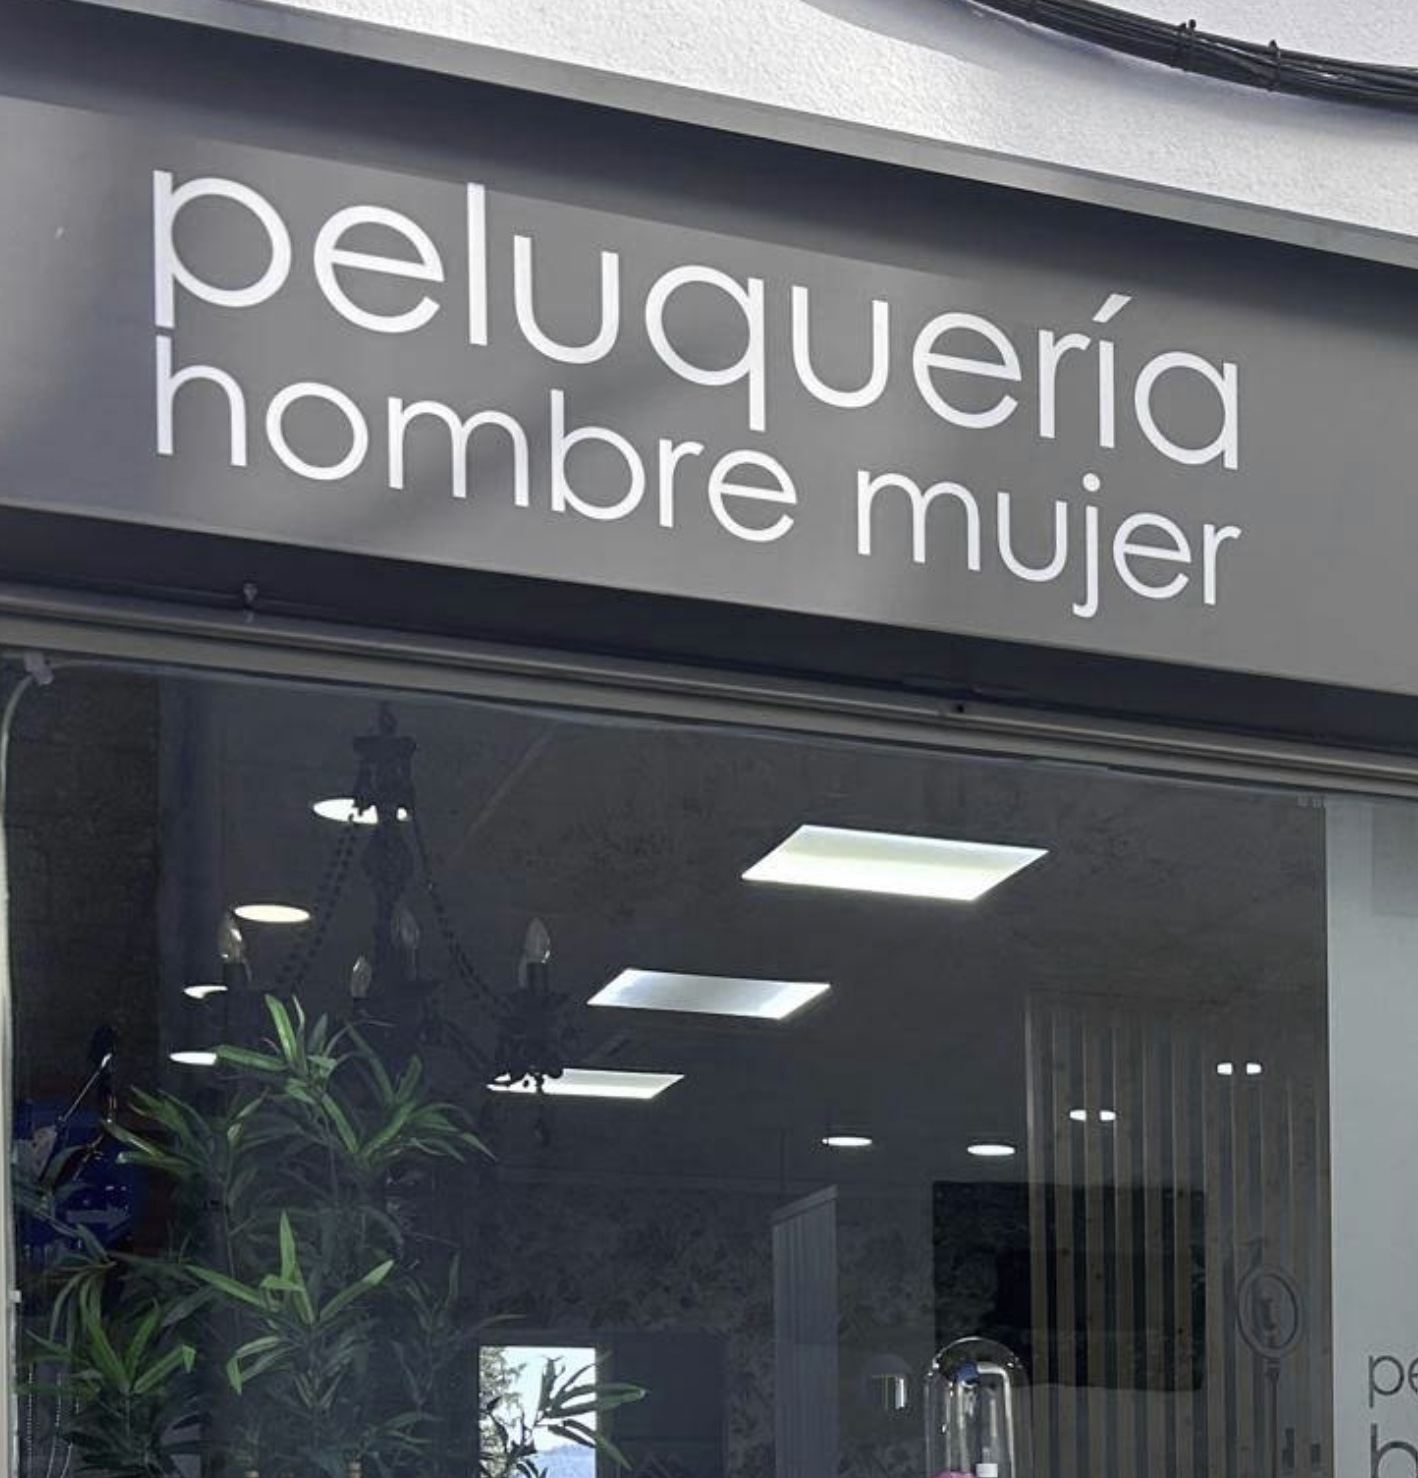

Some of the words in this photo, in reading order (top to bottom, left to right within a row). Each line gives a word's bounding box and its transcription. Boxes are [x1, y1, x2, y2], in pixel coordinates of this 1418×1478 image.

[153, 170, 1238, 470] peluquería
[156, 335, 798, 542] hombre
[857, 470, 1242, 618] mujer
